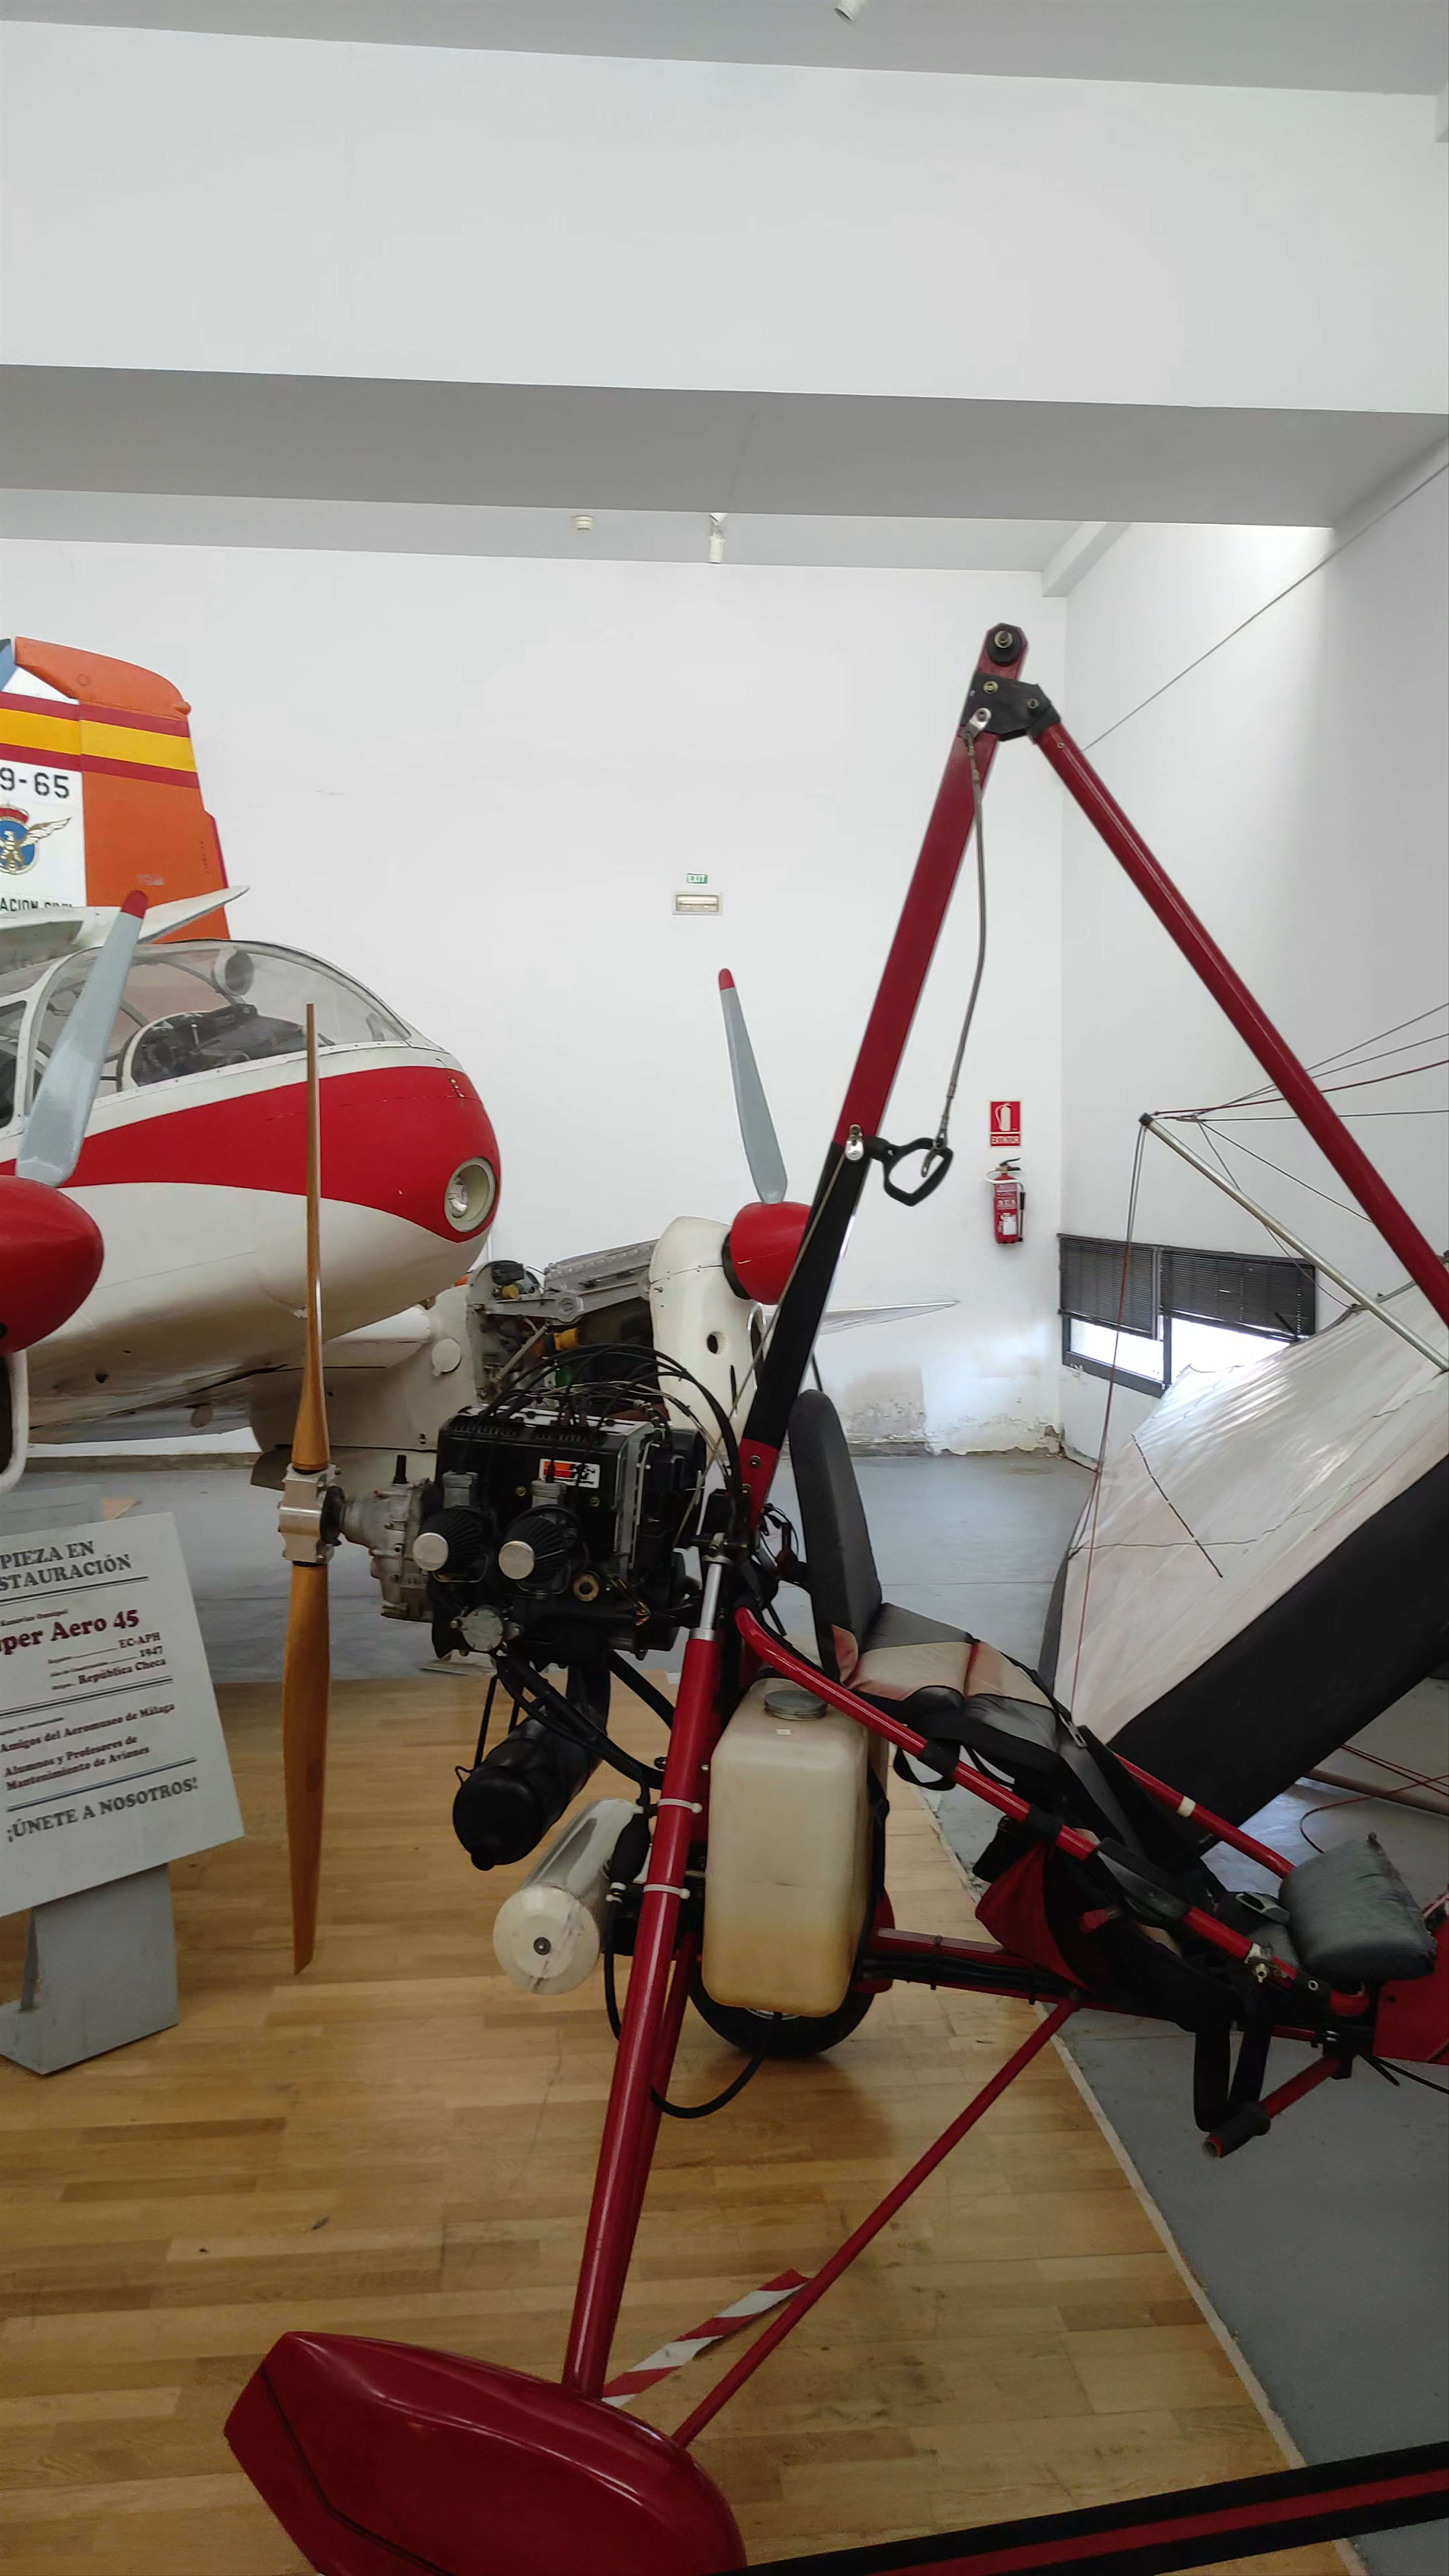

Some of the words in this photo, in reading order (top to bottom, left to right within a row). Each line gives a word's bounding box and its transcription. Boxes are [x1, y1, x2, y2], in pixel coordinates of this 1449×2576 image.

[0, 1546, 63, 1569] PIEZA
[66, 1541, 94, 1558] EN
[0, 1630, 43, 1655] per
[51, 1618, 107, 1641] Aero
[113, 1609, 140, 1629] 45
[139, 1646, 163, 1657] 1947
[78, 1666, 133, 1684] República
[1, 1737, 42, 1752] Amigos
[44, 1730, 61, 1741] del
[125, 1712, 137, 1721] de
[56, 1756, 63, 1765] y
[125, 1736, 137, 1744] de
[94, 1758, 106, 1767] de
[109, 1747, 149, 1763] Aviones
[7, 1809, 78, 1842] ¡ÚNETE
[82, 1805, 96, 1820] A
[97, 1776, 198, 1815] NOSOTROS!
